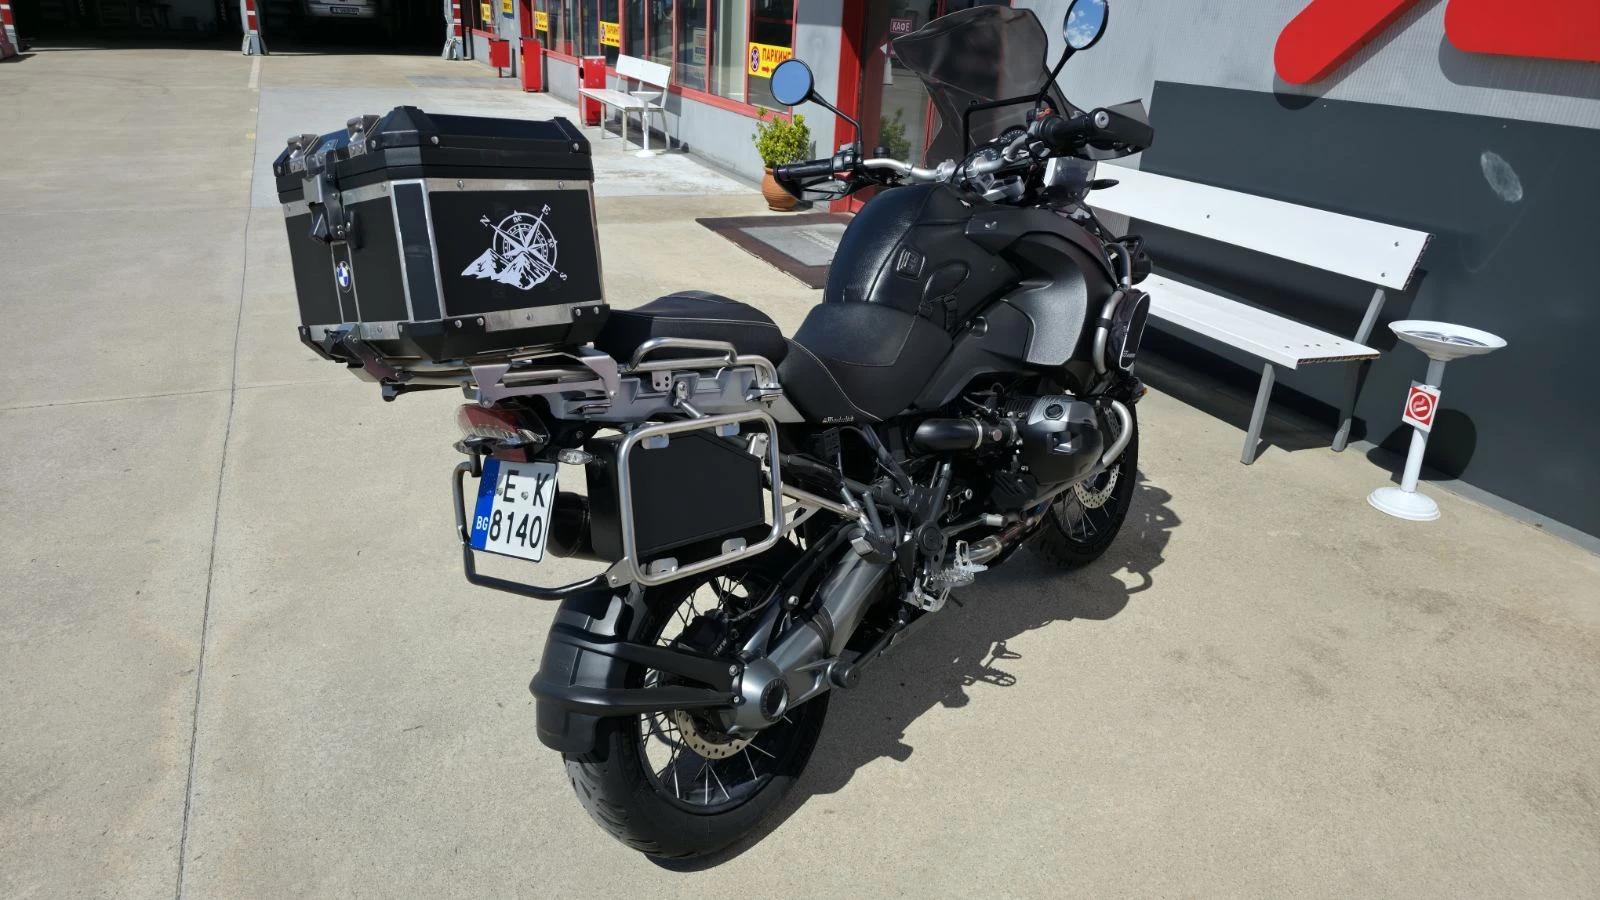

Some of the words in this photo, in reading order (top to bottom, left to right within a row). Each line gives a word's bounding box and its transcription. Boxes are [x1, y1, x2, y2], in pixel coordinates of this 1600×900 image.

[892, 21, 910, 32] КАФЕ
[541, 204, 551, 216] E
[480, 214, 491, 227] N
[559, 272, 568, 281] S
[503, 469, 520, 503] E
[532, 472, 550, 508] K
[476, 515, 489, 531] BG
[489, 509, 543, 549] 8140
